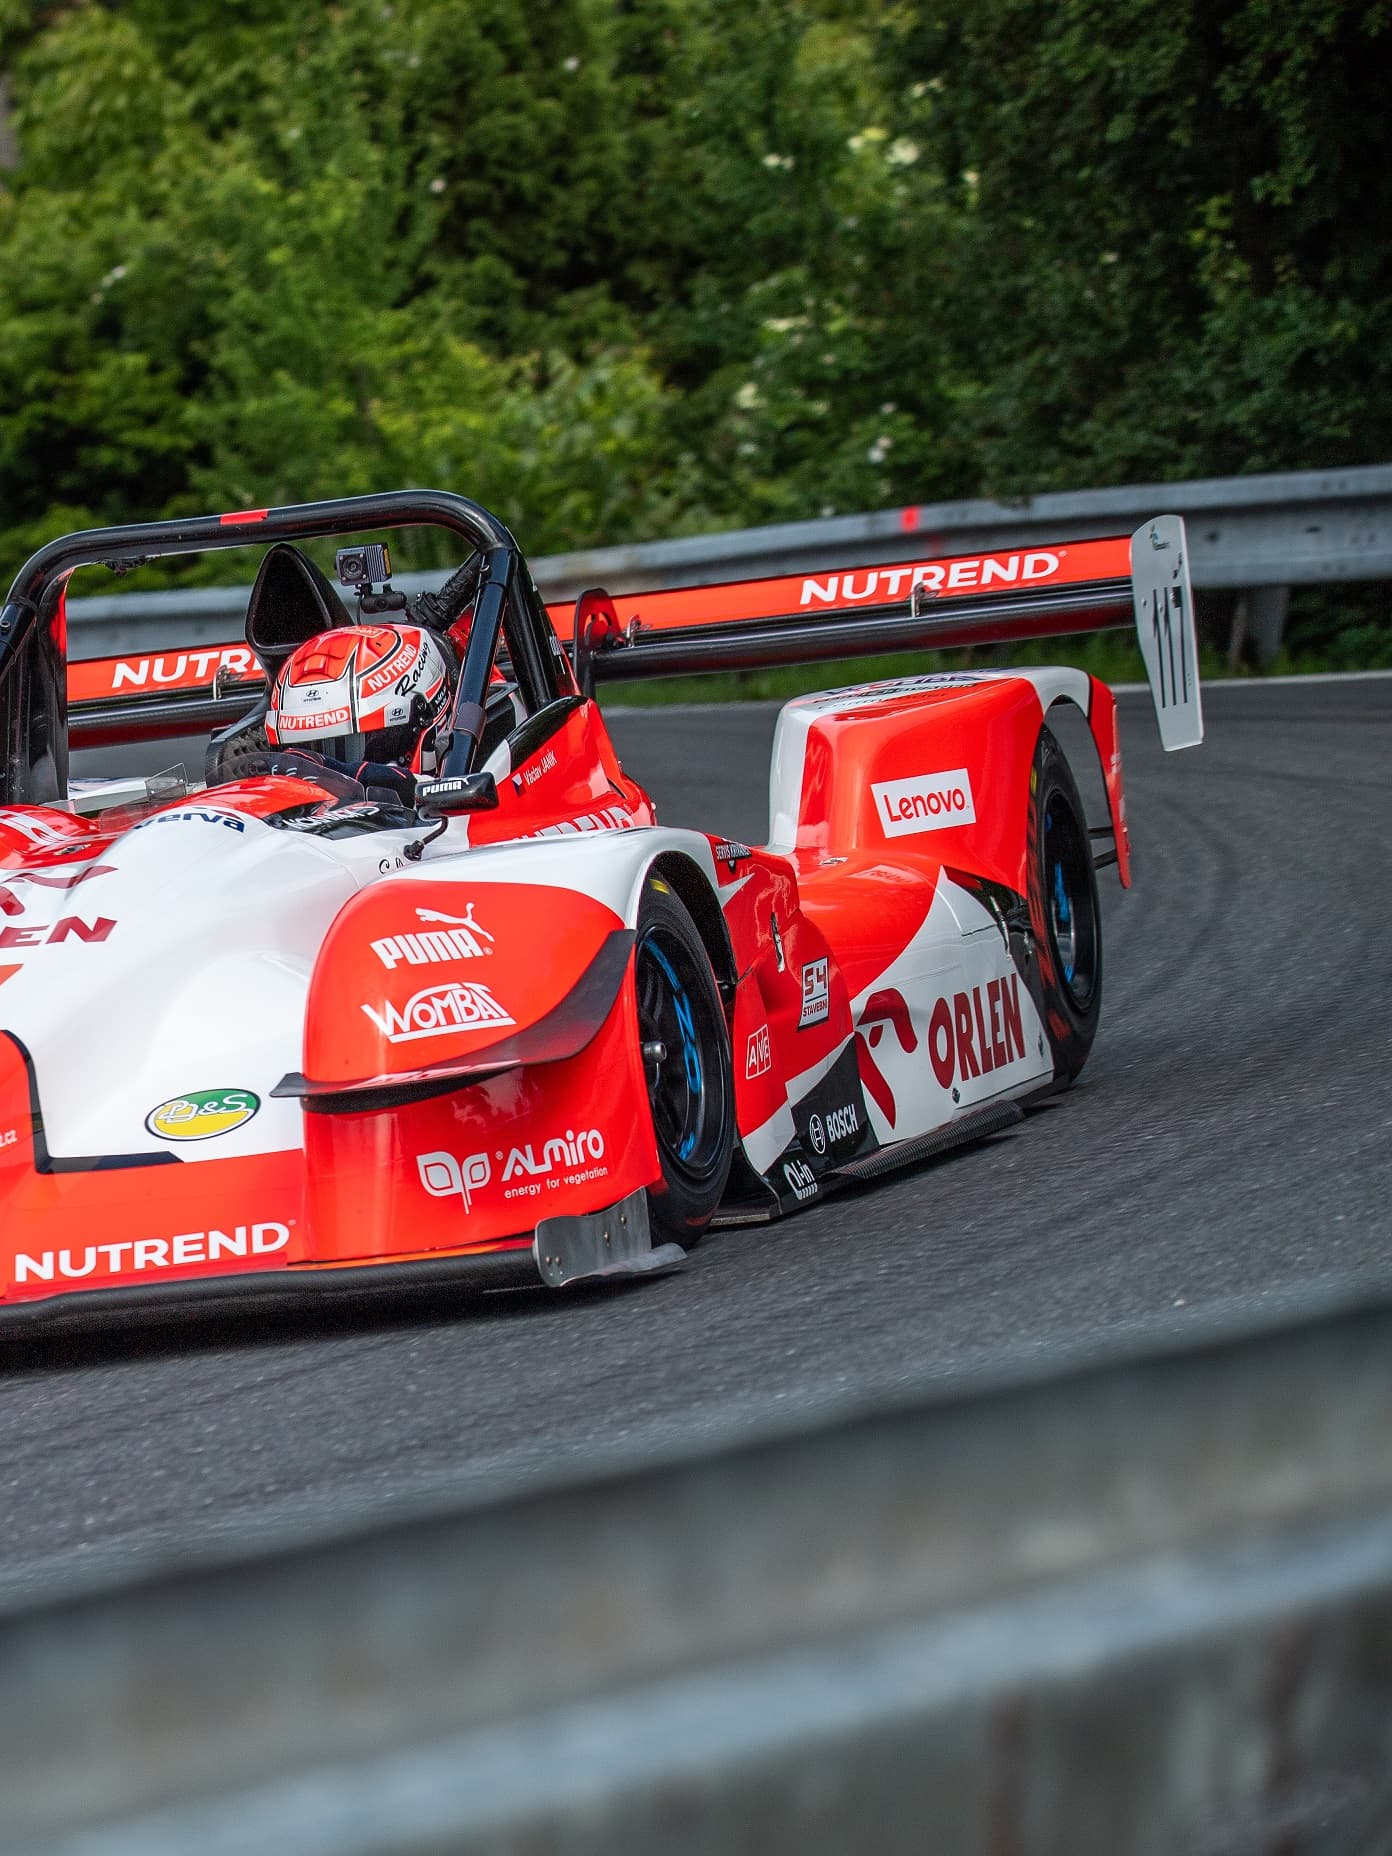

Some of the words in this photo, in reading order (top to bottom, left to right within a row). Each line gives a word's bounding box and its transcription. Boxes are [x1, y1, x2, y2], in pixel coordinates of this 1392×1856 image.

[800, 552, 1059, 604] NUTREND
[367, 644, 417, 691] NUTREND
[395, 642, 430, 697] Racing
[280, 709, 348, 730] NUTREND
[422, 780, 462, 797] PUMA
[883, 788, 966, 822] Lenovo
[369, 928, 485, 970] PUMA
[928, 972, 1026, 1090] ORLEN
[826, 1103, 859, 1143] BOSCH
[504, 1183, 541, 1199] energy
[546, 1178, 560, 1190] for
[563, 1166, 608, 1185] vegetation
[15, 1222, 290, 1282] NUTREND
